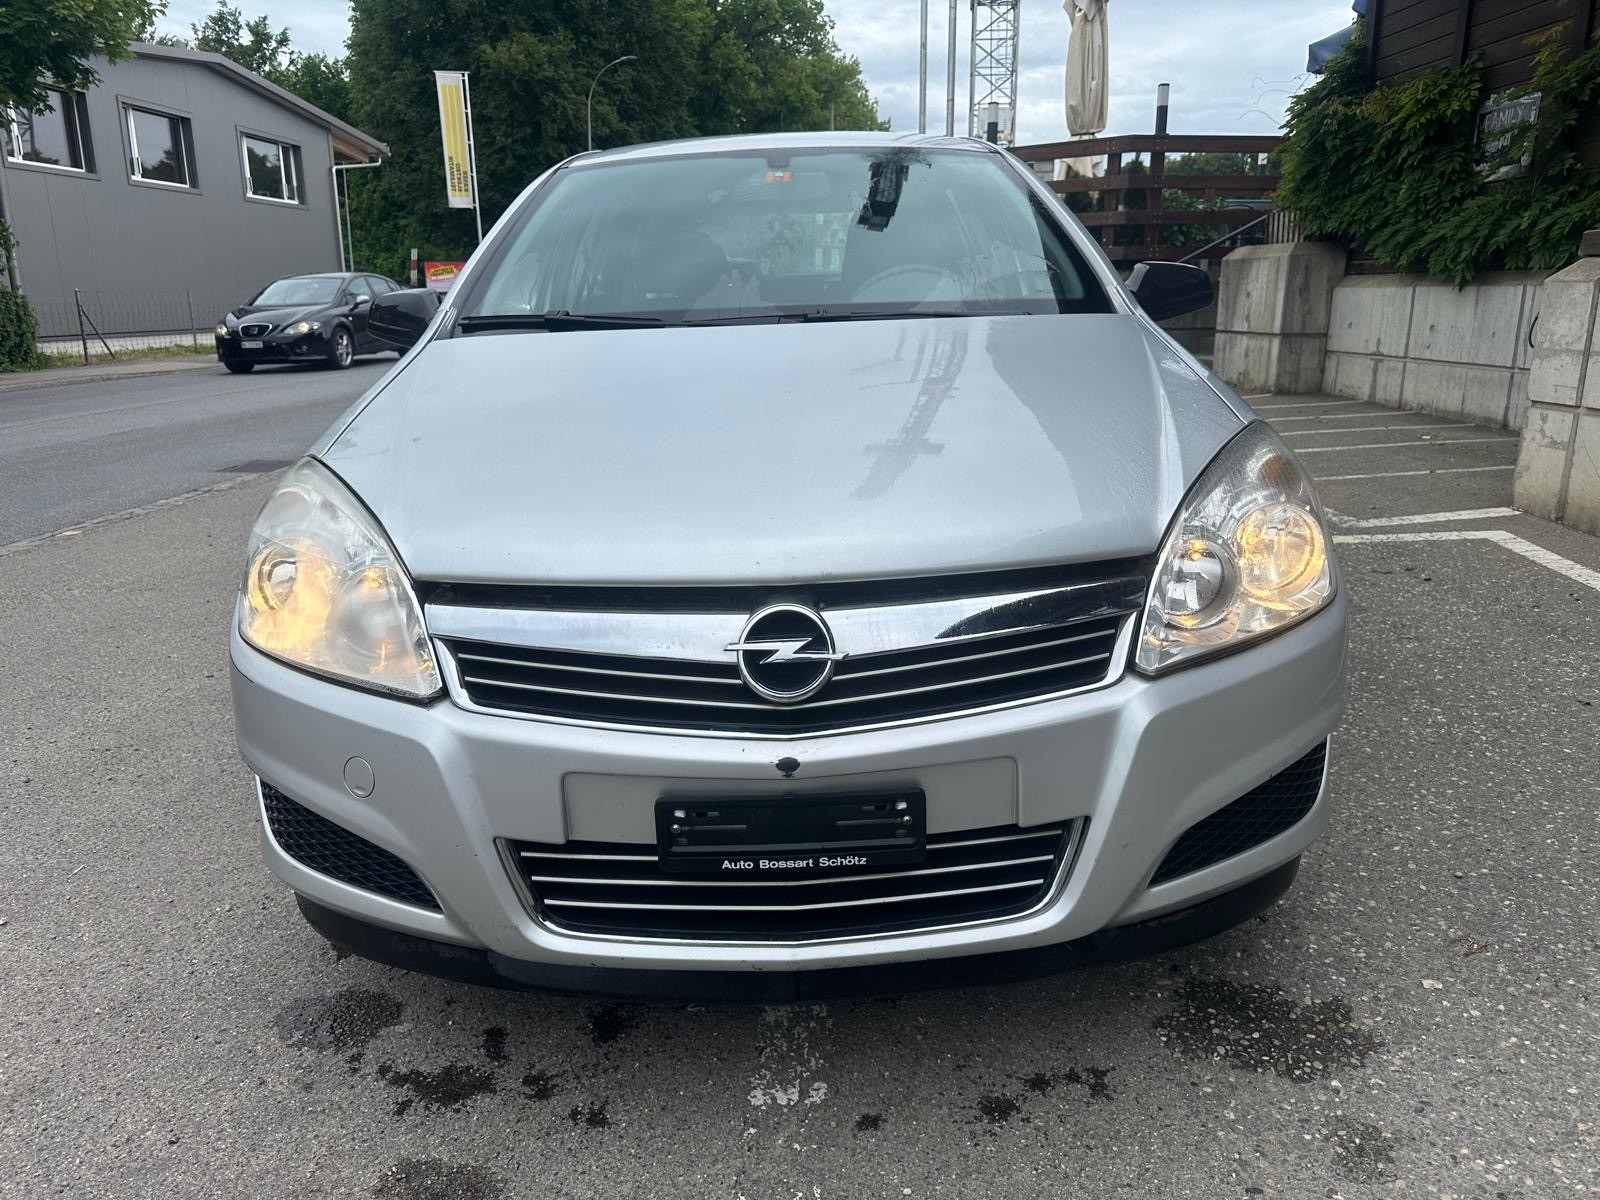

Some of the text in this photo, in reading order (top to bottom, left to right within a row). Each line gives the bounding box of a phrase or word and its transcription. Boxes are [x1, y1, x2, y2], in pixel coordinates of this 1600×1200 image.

[722, 855, 867, 870] Auto Bossart Schötz
